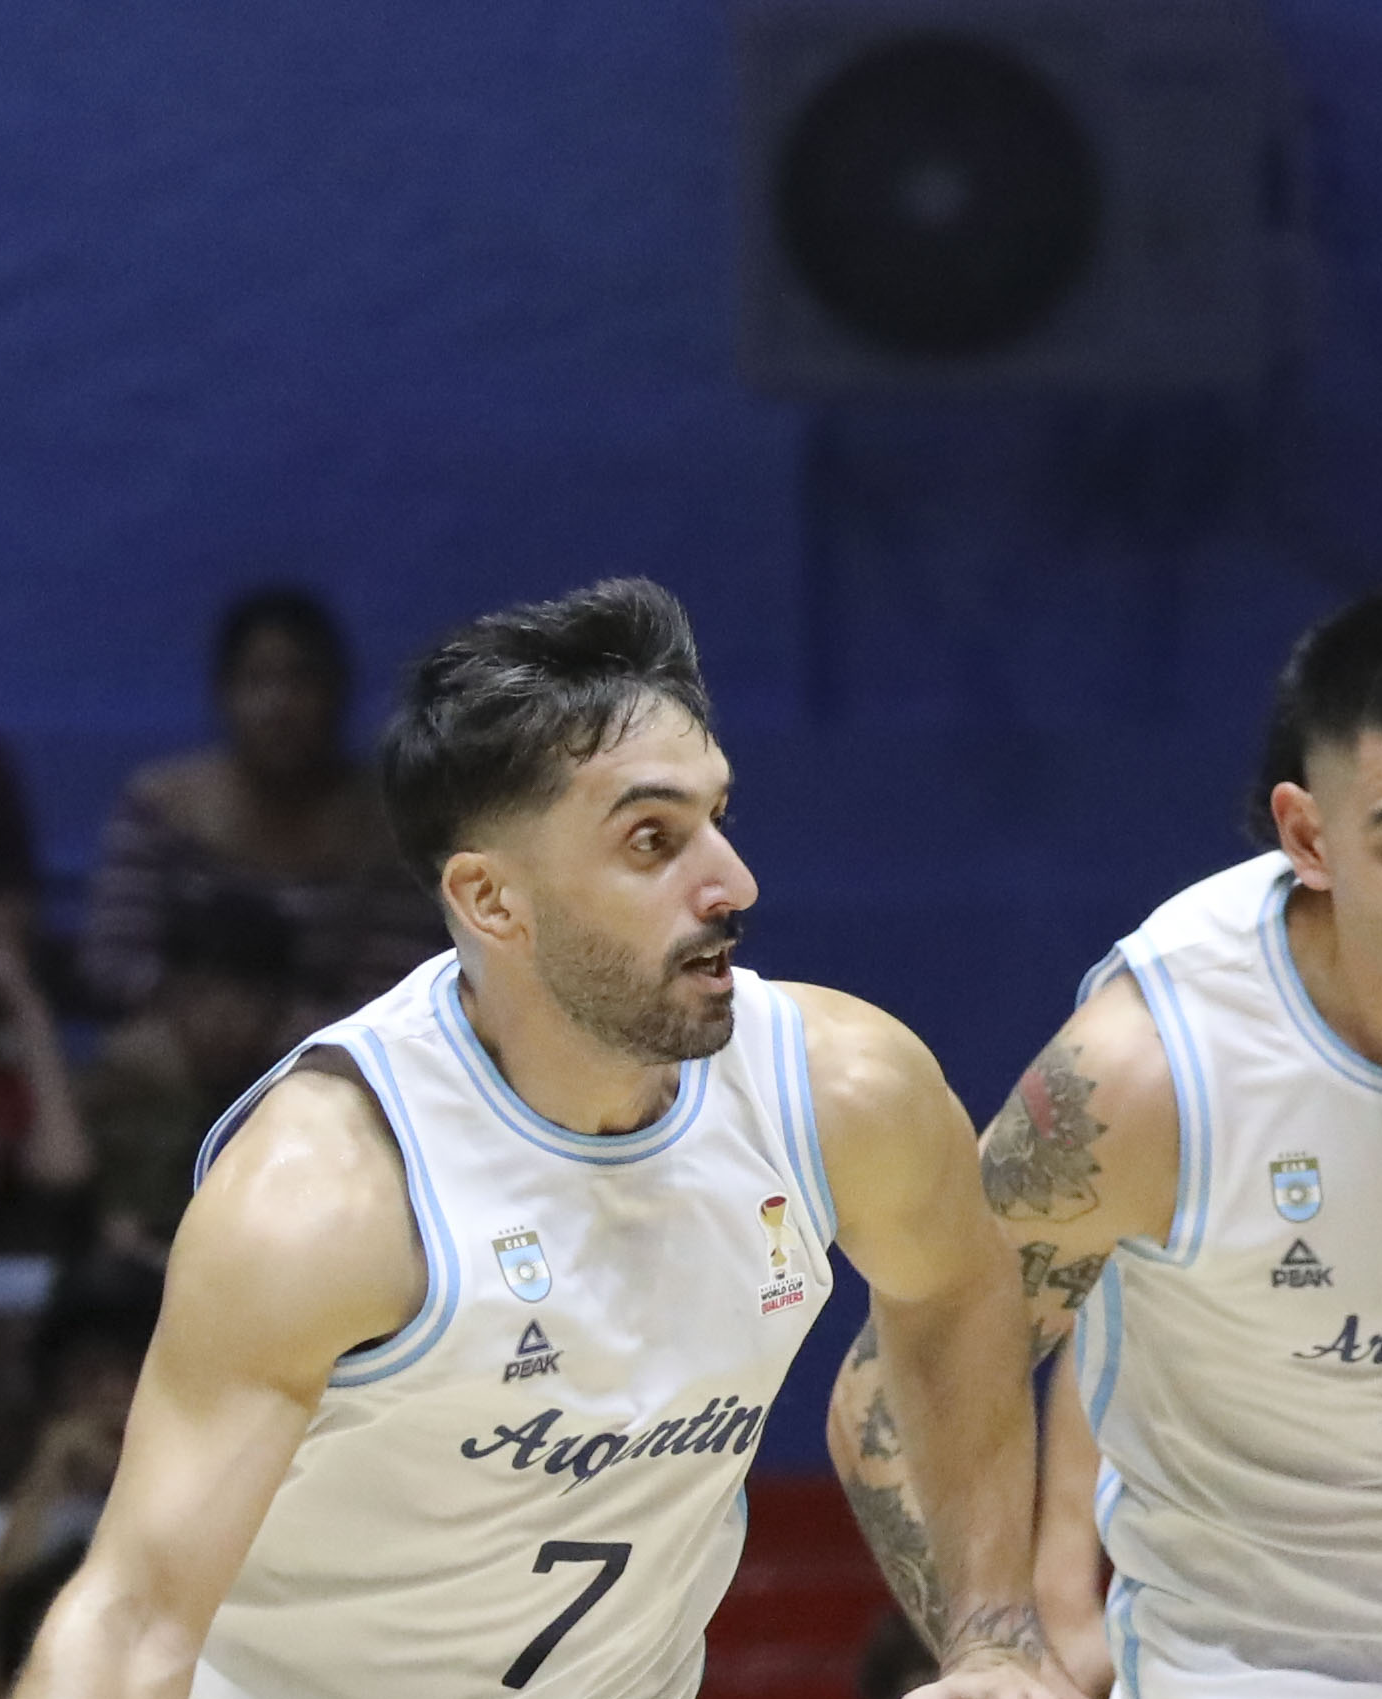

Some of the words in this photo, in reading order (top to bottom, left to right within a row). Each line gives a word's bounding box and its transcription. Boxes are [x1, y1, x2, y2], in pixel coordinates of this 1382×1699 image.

[1271, 1267, 1334, 1289] PEAK
[502, 1350, 565, 1384] PEAK
[501, 1539, 633, 1690] 7
